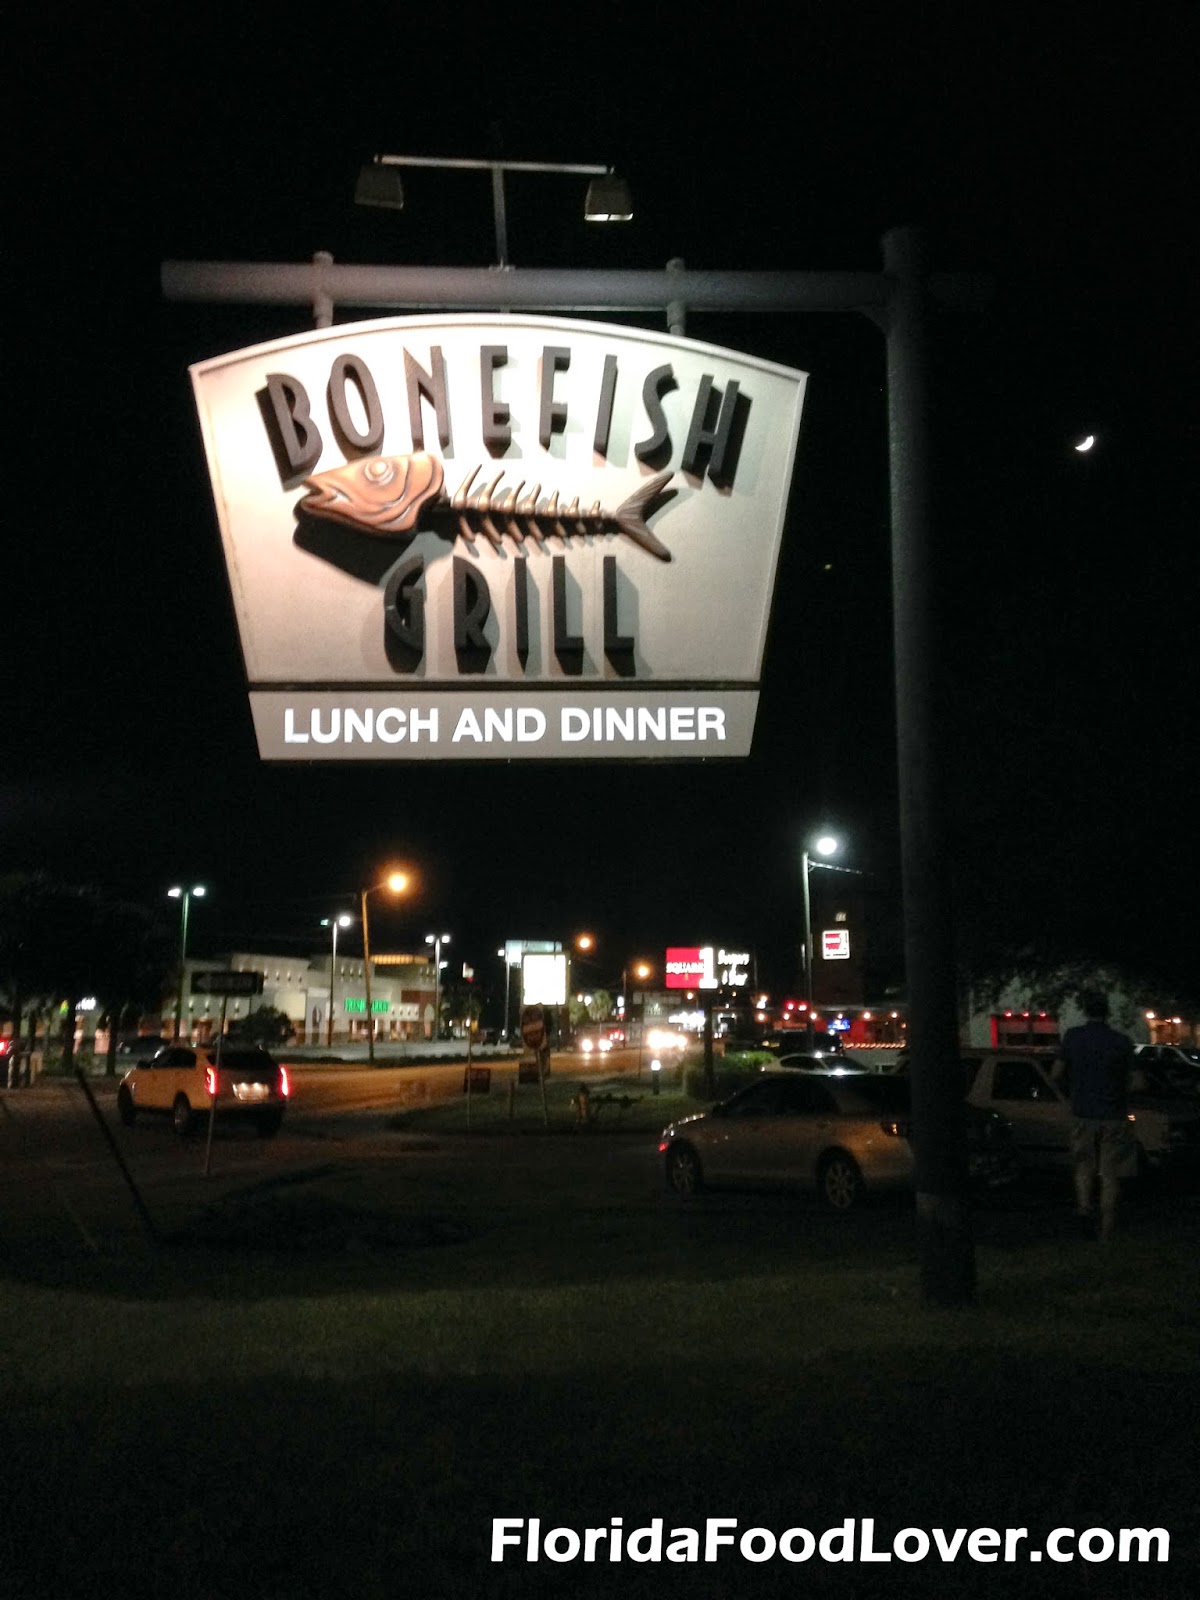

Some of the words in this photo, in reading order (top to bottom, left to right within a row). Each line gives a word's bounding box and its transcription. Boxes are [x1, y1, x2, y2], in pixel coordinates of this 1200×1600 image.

[255, 345, 752, 495] BONEFISH
[384, 554, 636, 677] GRILL
[283, 707, 439, 744] LUNCH
[452, 707, 547, 742] AND
[561, 707, 727, 742] DINNER
